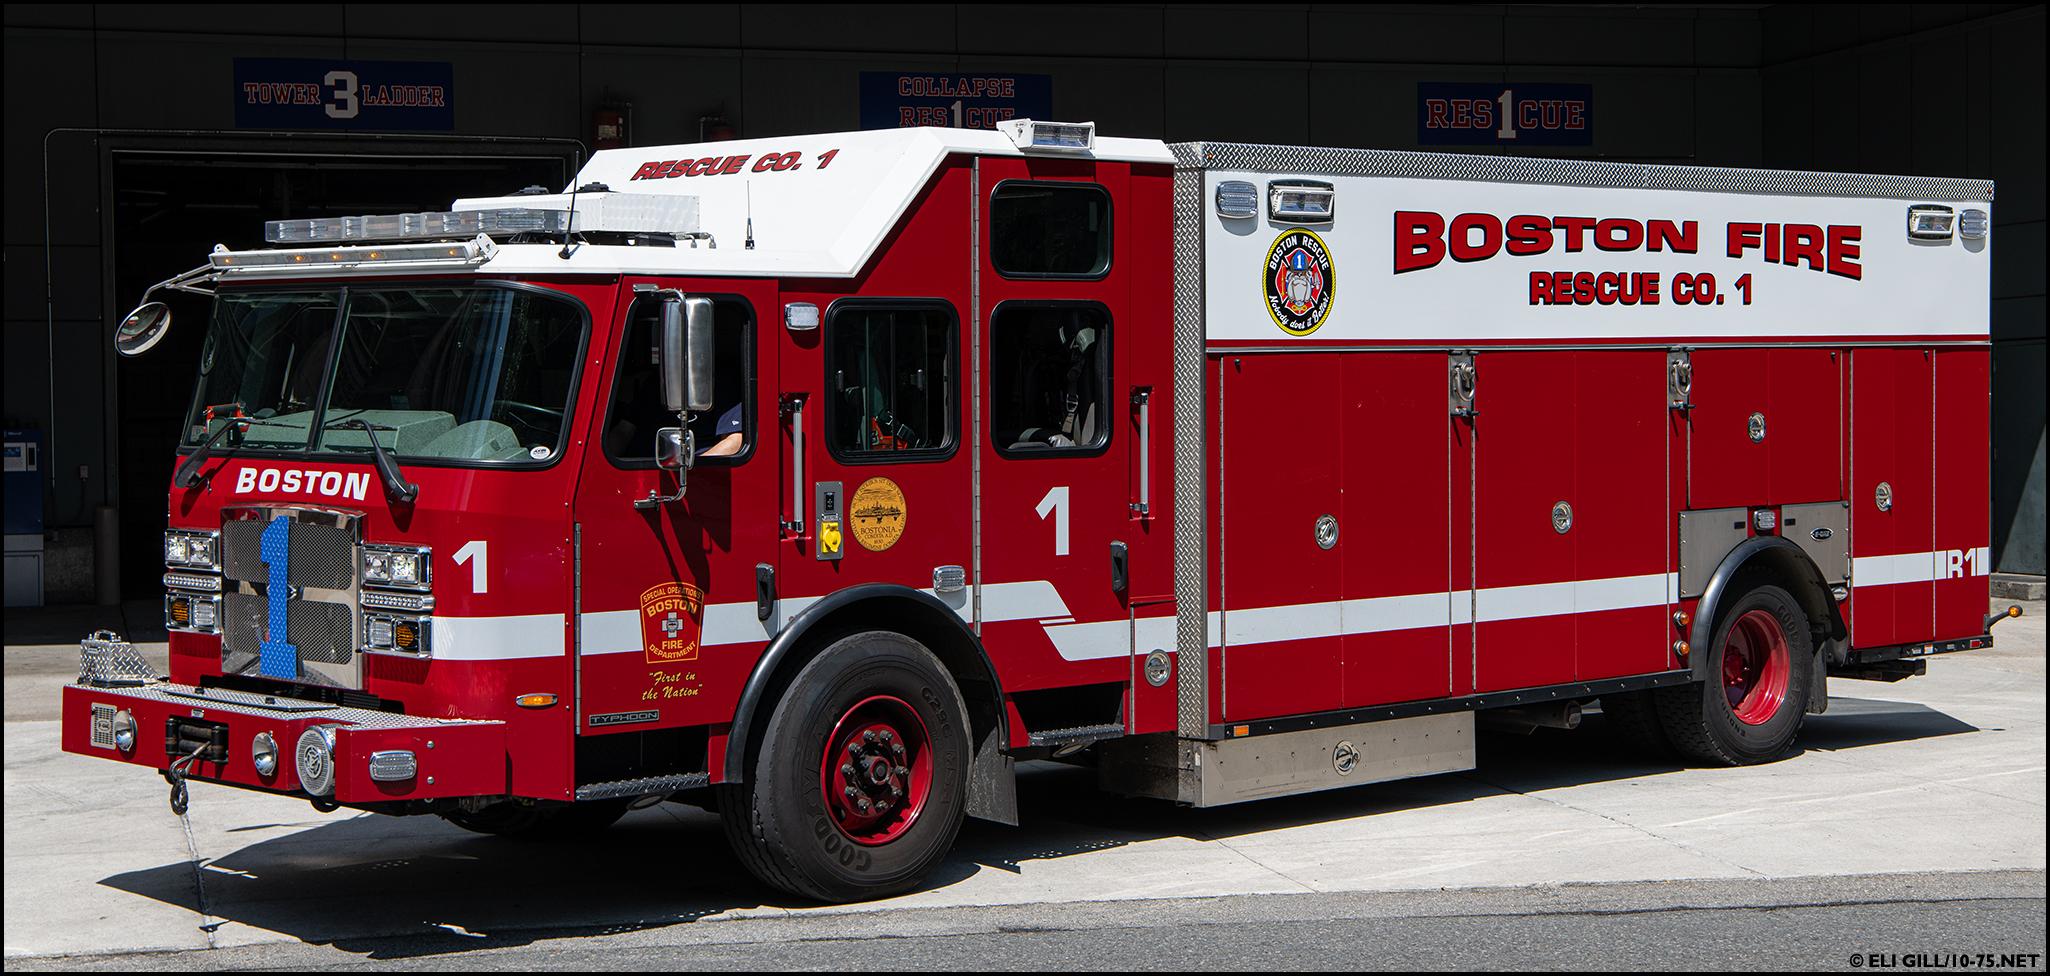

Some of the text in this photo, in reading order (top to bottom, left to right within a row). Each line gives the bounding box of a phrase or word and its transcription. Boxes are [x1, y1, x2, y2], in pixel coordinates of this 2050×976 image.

[244, 70, 445, 119] TOWER 3 LADDER
[898, 77, 1015, 98] COLLAPSE
[629, 149, 841, 181] RESCUE CO. 1
[1268, 235, 1330, 271] BOSTON RESCUE
[1296, 254, 1302, 269] 1
[1394, 210, 1863, 282] BOSTON FIRE
[1529, 271, 1753, 306] RESCUE CO. 1
[1268, 295, 1290, 326] Nobody
[1289, 319, 1306, 330] does
[235, 467, 371, 501] BOSTON
[1035, 486, 1070, 556] 1
[451, 540, 488, 594] 1
[1947, 548, 1977, 579] R1
[260, 515, 297, 680] 1
[643, 586, 702, 603] SPECIAL OPERATIONS
[646, 599, 698, 618] BOSTON
[649, 641, 696, 659] DEPARTMENT
[661, 639, 683, 650] FIRE
[685, 671, 696, 681] in
[641, 688, 658, 701] the
[591, 712, 658, 723] TYPHOON
[920, 686, 952, 739] G296
